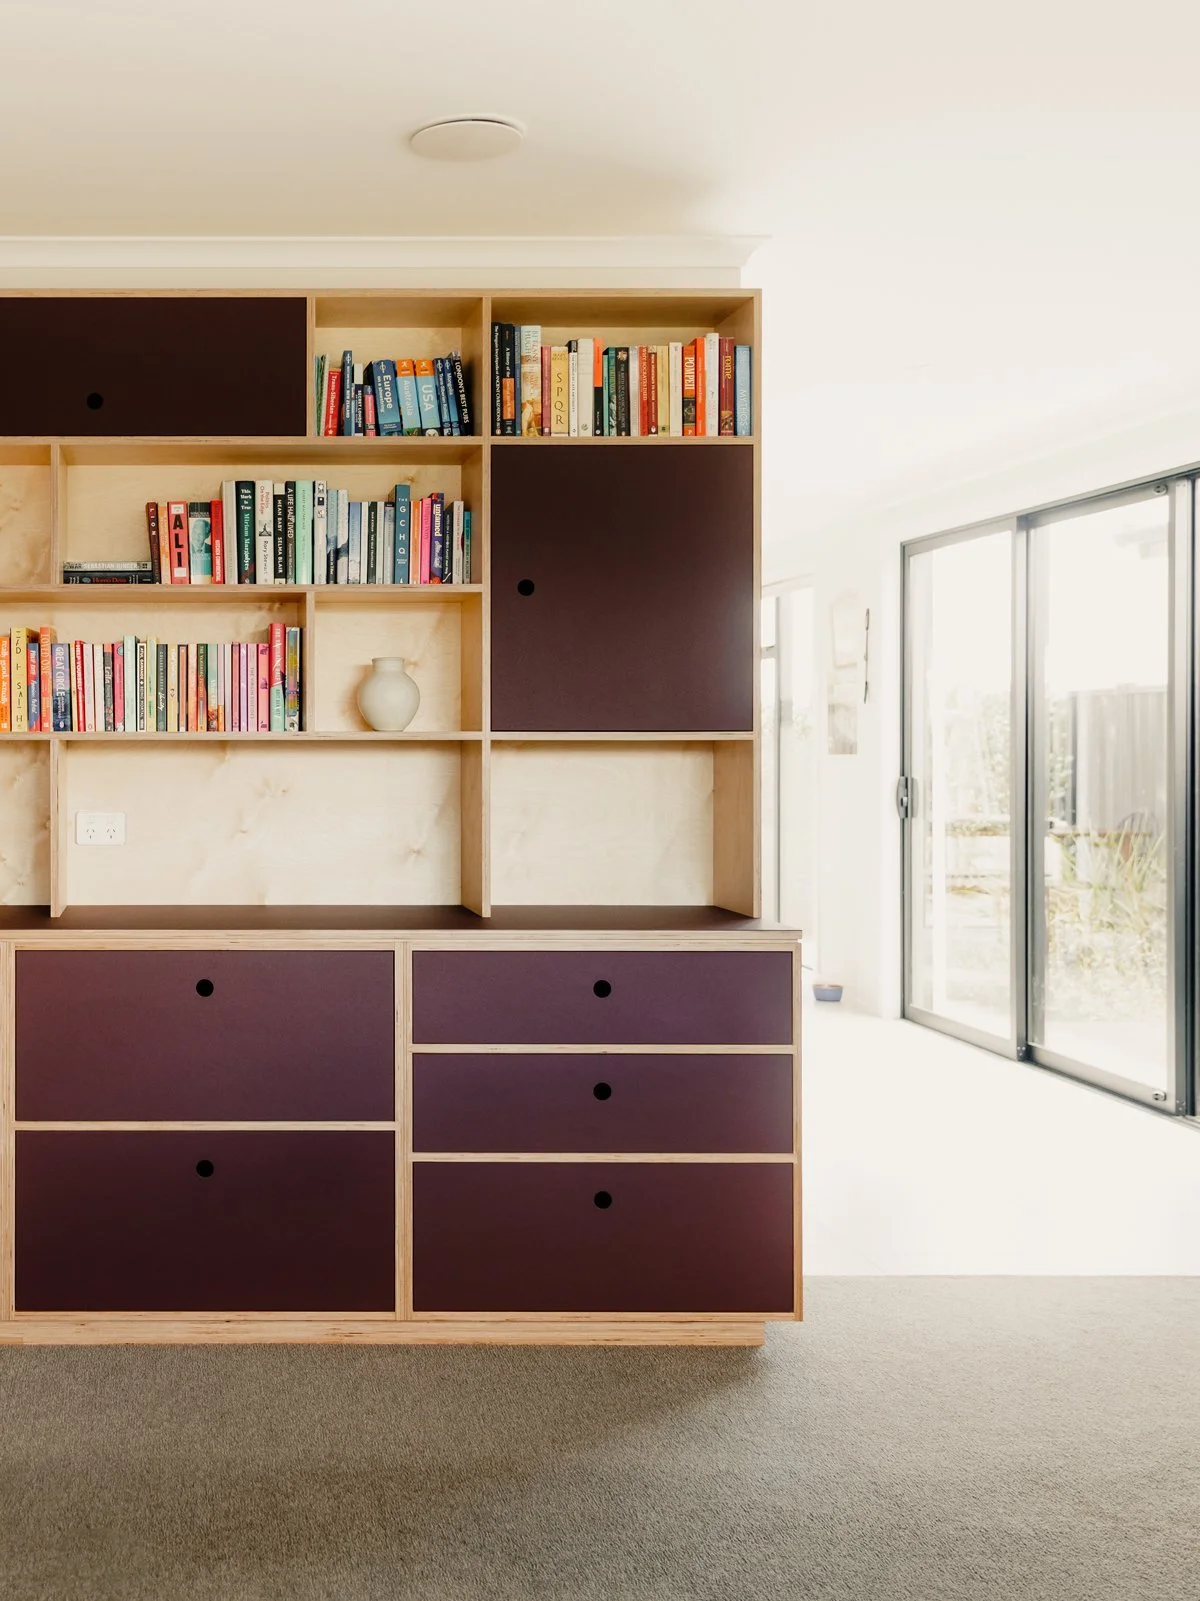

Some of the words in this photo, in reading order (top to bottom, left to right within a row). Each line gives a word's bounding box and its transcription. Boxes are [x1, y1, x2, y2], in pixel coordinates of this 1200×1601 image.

[524, 330, 532, 363] HUGHES
[455, 362, 465, 393] LONDON'S
[684, 357, 695, 390] POMPEII
[724, 356, 732, 379] rome
[377, 387, 385, 413] shoestring
[382, 375, 393, 408] Europe
[403, 380, 413, 416] Australia
[422, 384, 434, 411] USA
[739, 389, 747, 426] MYTHOS
[434, 504, 442, 536] untamed
[173, 514, 184, 567] ALI
[41, 634, 49, 657] LOVED
[55, 646, 65, 670] GREAT
[56, 671, 66, 697] CIRCLE
